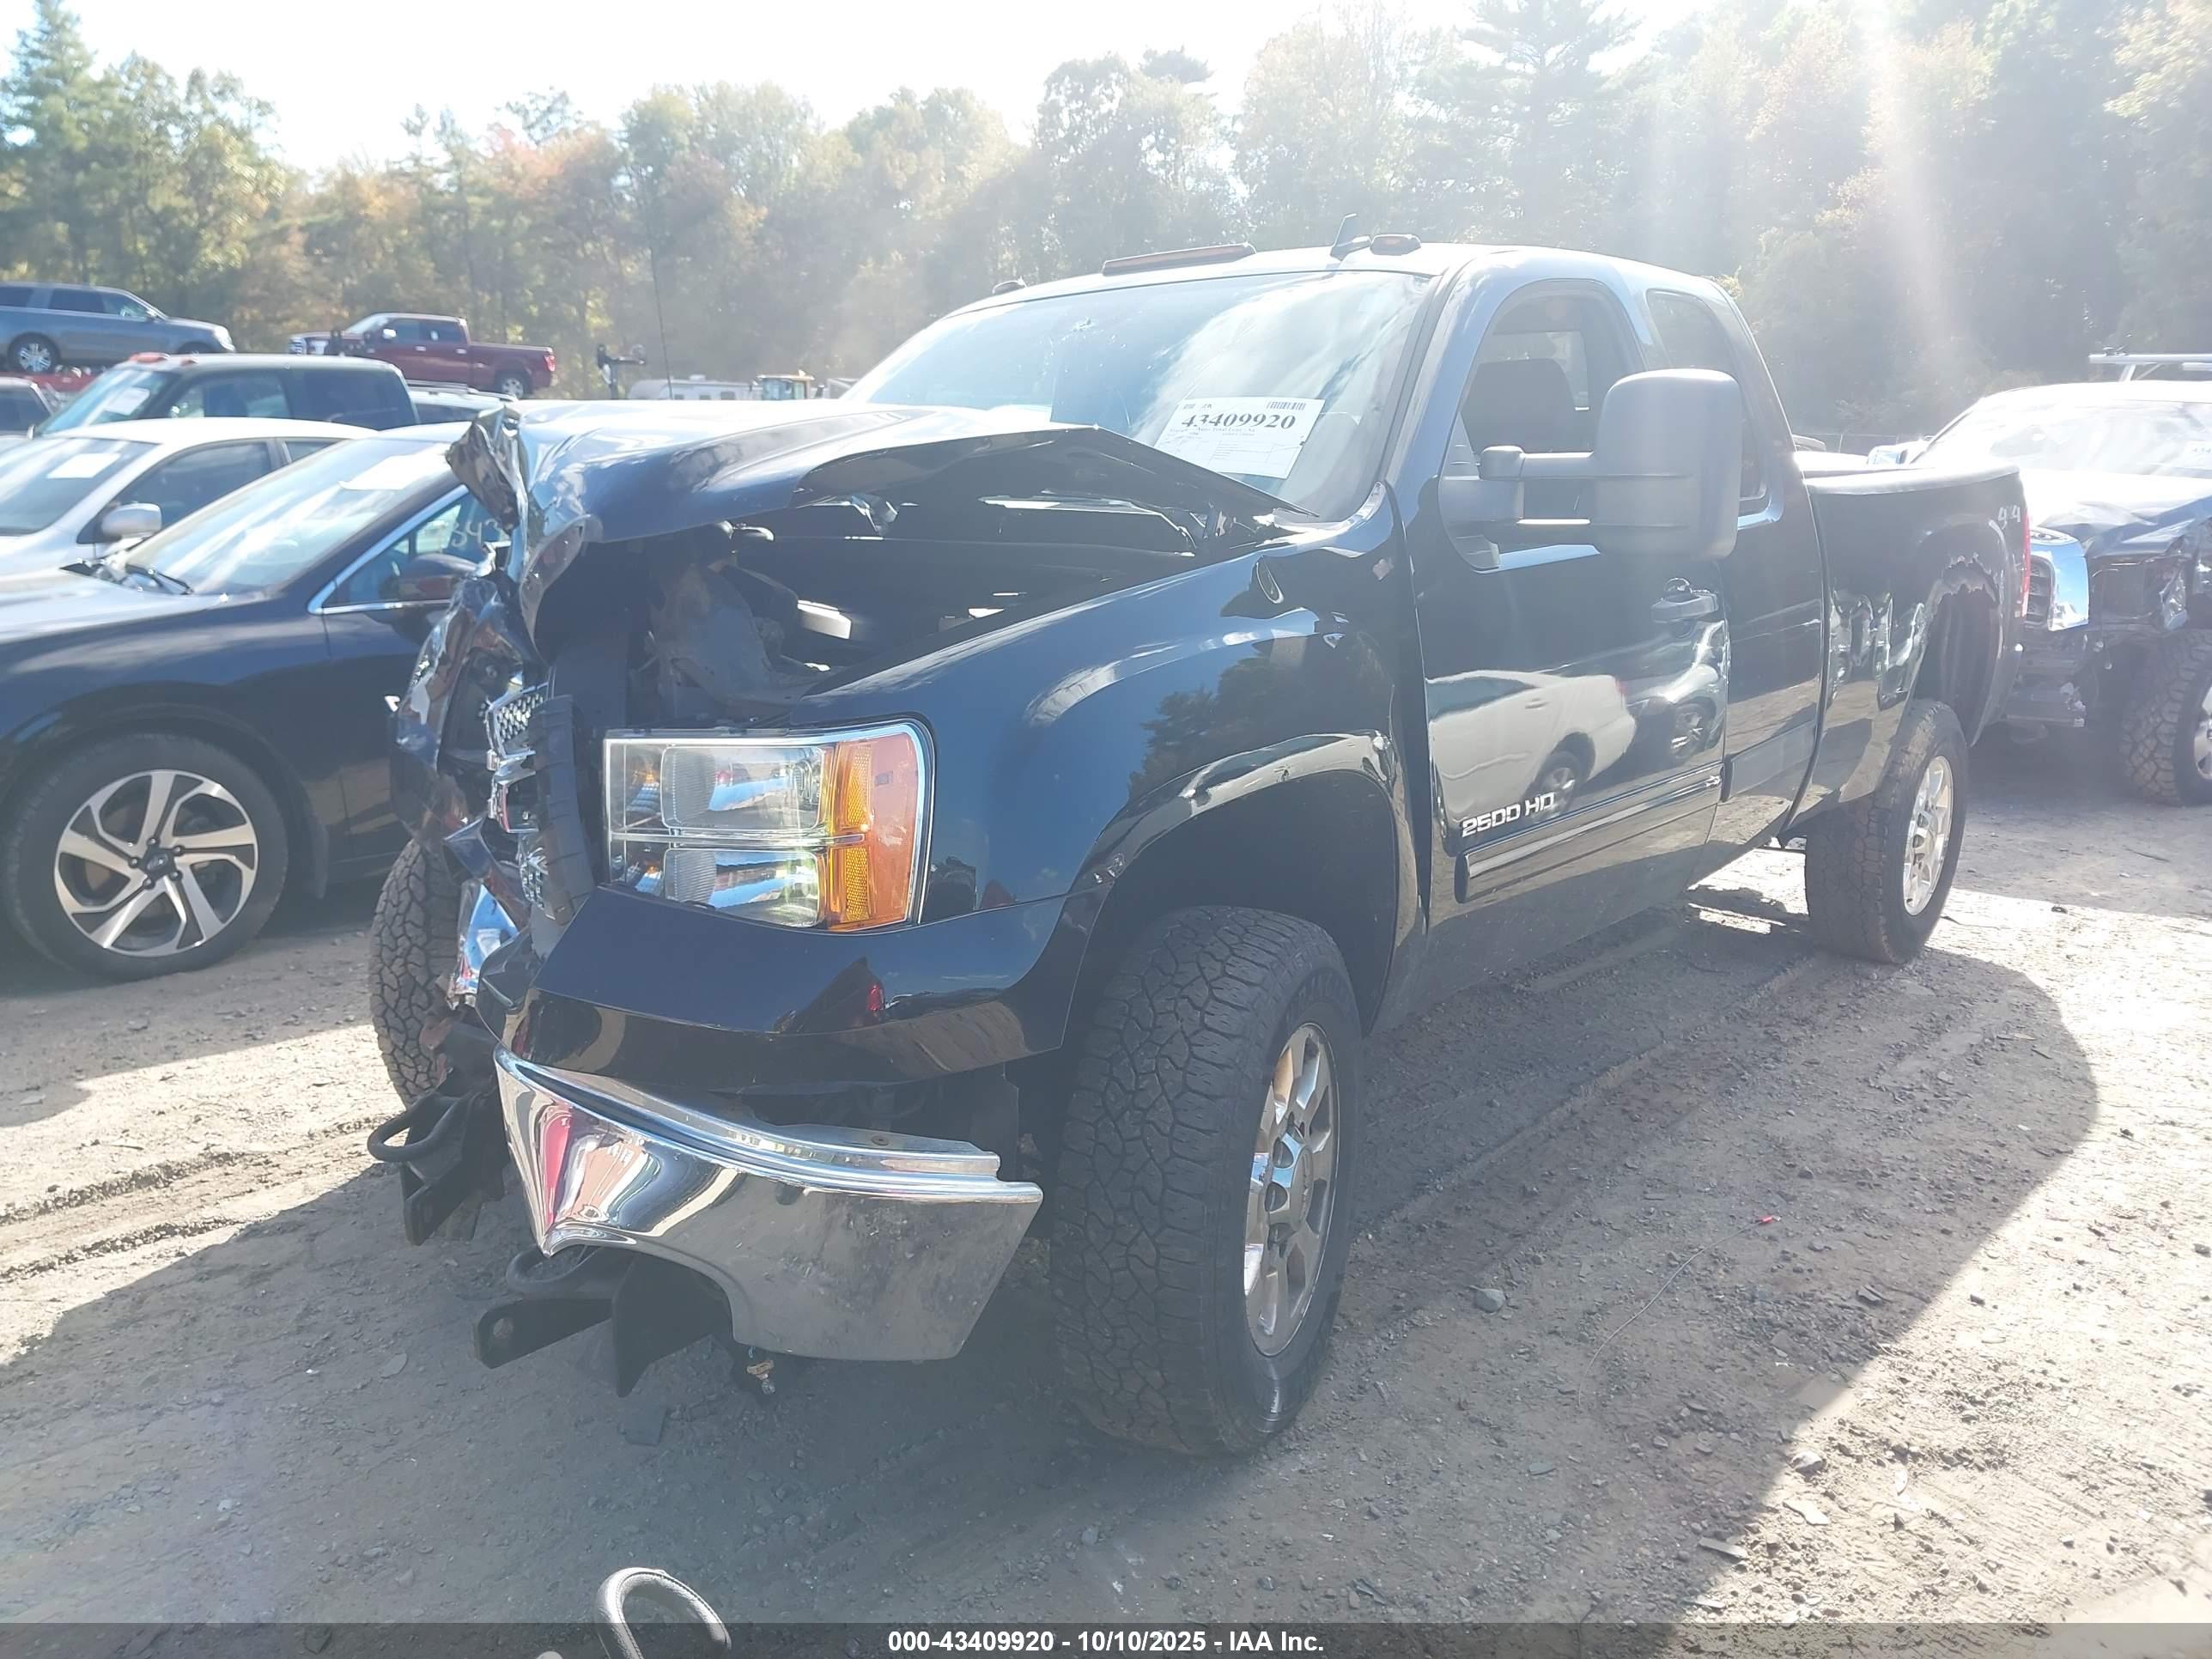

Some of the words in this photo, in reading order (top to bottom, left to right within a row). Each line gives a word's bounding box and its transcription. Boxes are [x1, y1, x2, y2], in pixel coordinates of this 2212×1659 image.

[1182, 413, 1296, 429] 43409920
[1462, 803, 1521, 838] 2500
[1524, 792, 1555, 816] HD
